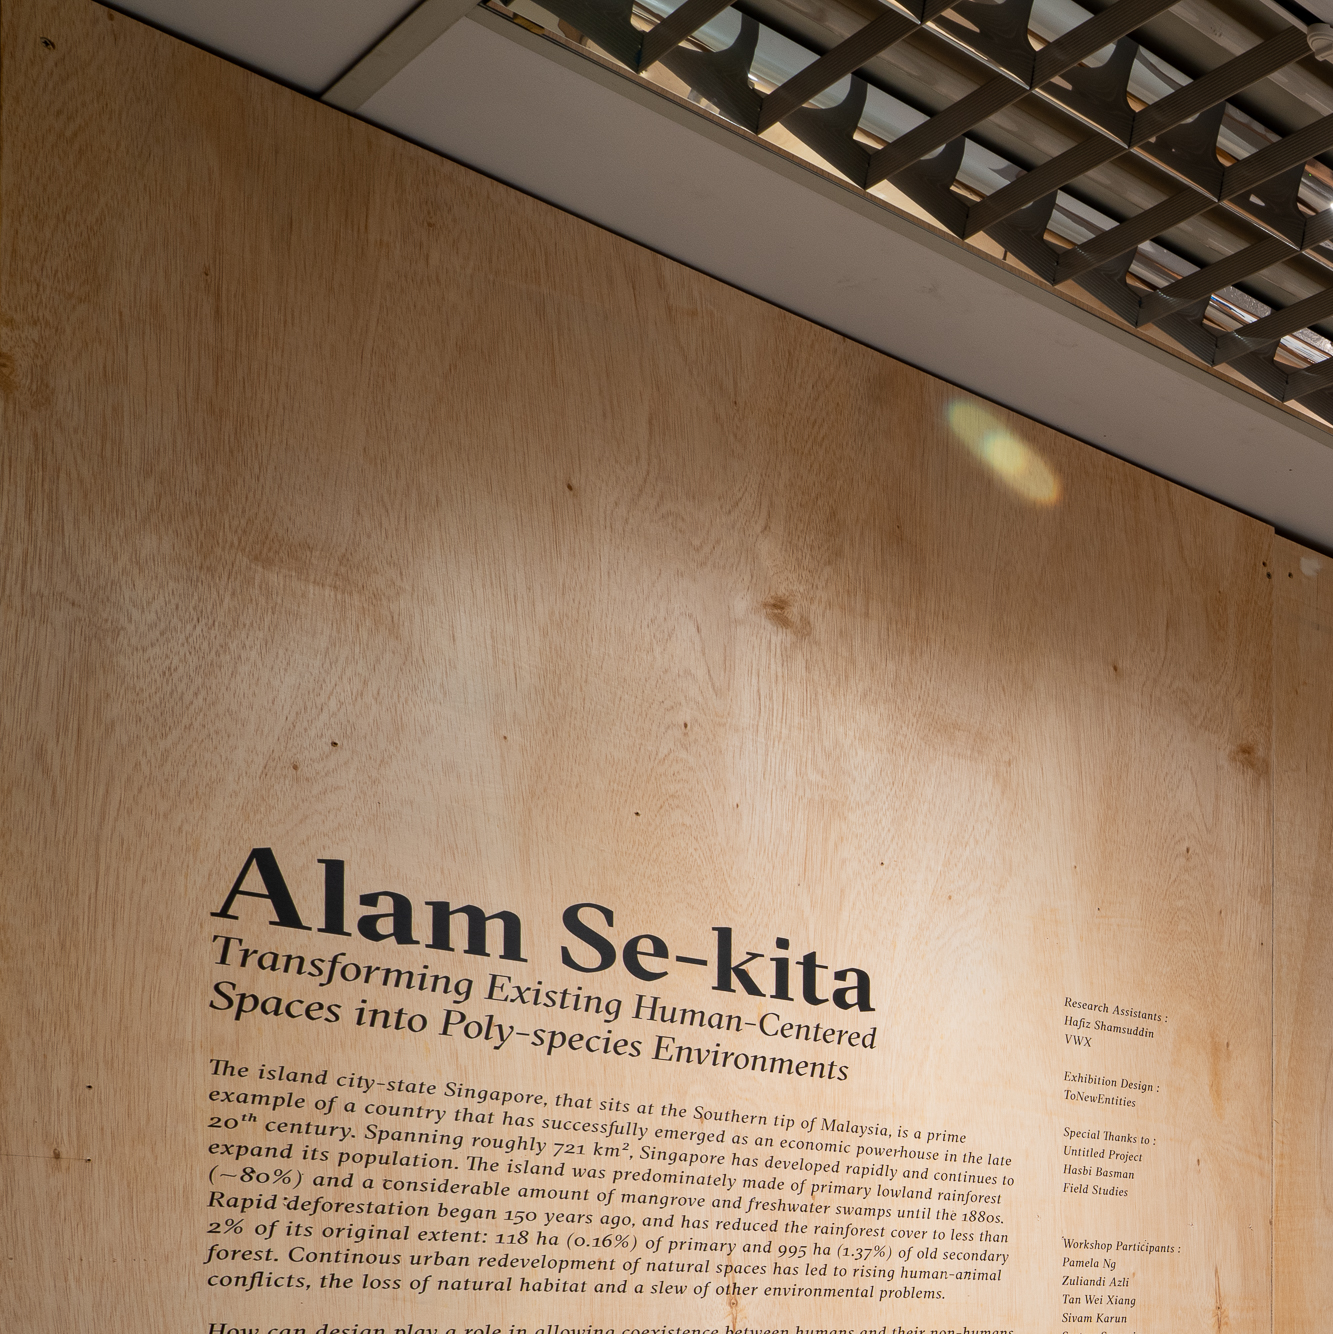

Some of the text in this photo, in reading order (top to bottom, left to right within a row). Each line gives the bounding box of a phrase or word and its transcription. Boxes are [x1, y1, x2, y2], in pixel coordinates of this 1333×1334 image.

[210, 847, 876, 1012] Alam Se-kita
[212, 935, 877, 1049] Transforming Existing Human-Centered
[1064, 997, 1109, 1013] Research
[1112, 1005, 1162, 1022] Assistants
[209, 981, 849, 1081] Spaces into Poly-species Environments
[1064, 1016, 1154, 1038] Hafiz Shamsuddin
[1065, 1034, 1092, 1047] VWX
[1064, 1071, 1117, 1087] Exhibition
[1121, 1079, 1153, 1093] Design
[210, 1059, 967, 1144] The island city-state Singapore, that sits at the Southern tip of Malaysia, is a prime
[1064, 1090, 1136, 1107] ToNewEntities
[1063, 1127, 1101, 1140] Special
[1103, 1131, 1138, 1143] Thanks
[1064, 1146, 1142, 1163] Untitled Project
[1063, 1164, 1135, 1179] Hasbi Basman
[1063, 1183, 1129, 1197] Field Studies
[1062, 1238, 1113, 1253] Workshop
[1116, 1241, 1175, 1254] Participants
[1063, 1257, 1116, 1271] Pamela Ng
[1063, 1294, 1136, 1308] Tan Wei Xiang
